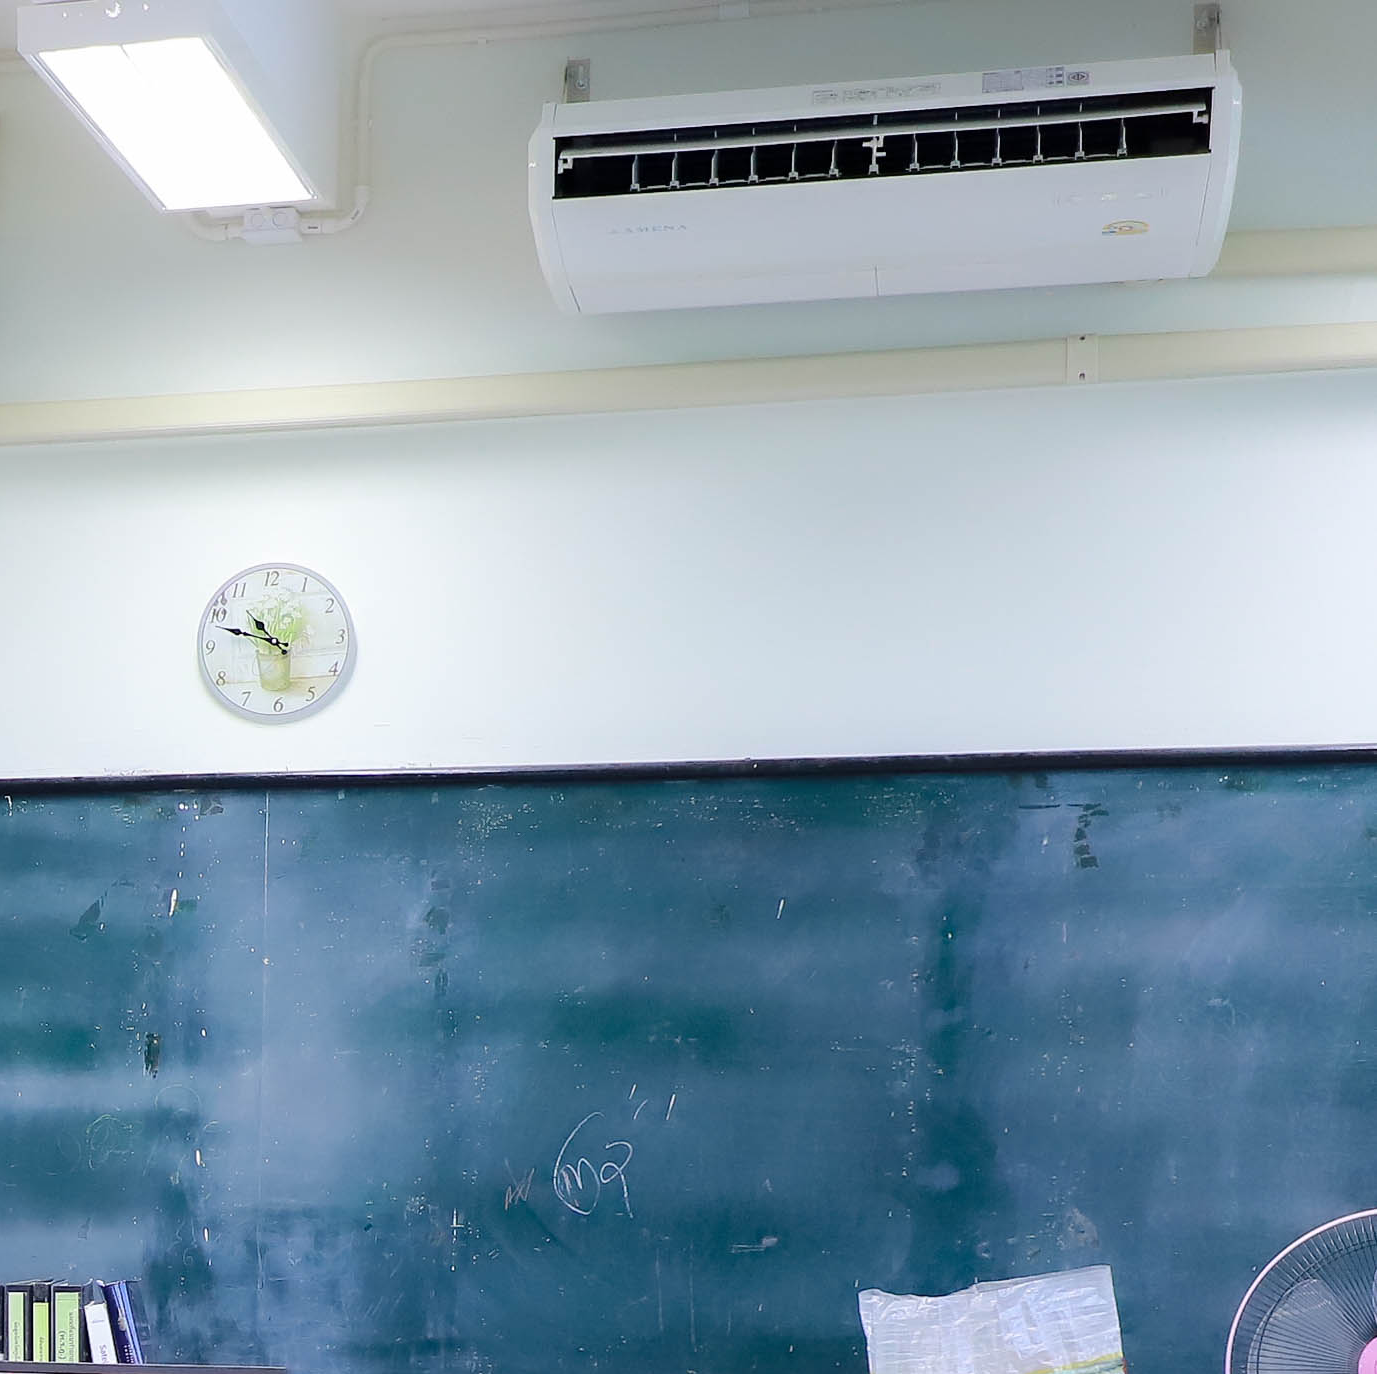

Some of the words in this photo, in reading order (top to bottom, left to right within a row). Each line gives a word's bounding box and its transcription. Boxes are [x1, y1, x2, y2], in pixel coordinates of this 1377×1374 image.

[264, 571, 280, 586] 12
[301, 577, 308, 592] 1
[232, 582, 247, 598] 11
[325, 598, 335, 614] 2
[210, 607, 227, 623] 10
[335, 628, 345, 645] 3
[205, 639, 216, 655] 9
[328, 661, 339, 677] 4
[215, 670, 226, 687] 8
[241, 691, 252, 707] 7
[305, 686, 316, 702] 5
[273, 696, 284, 712] 6
